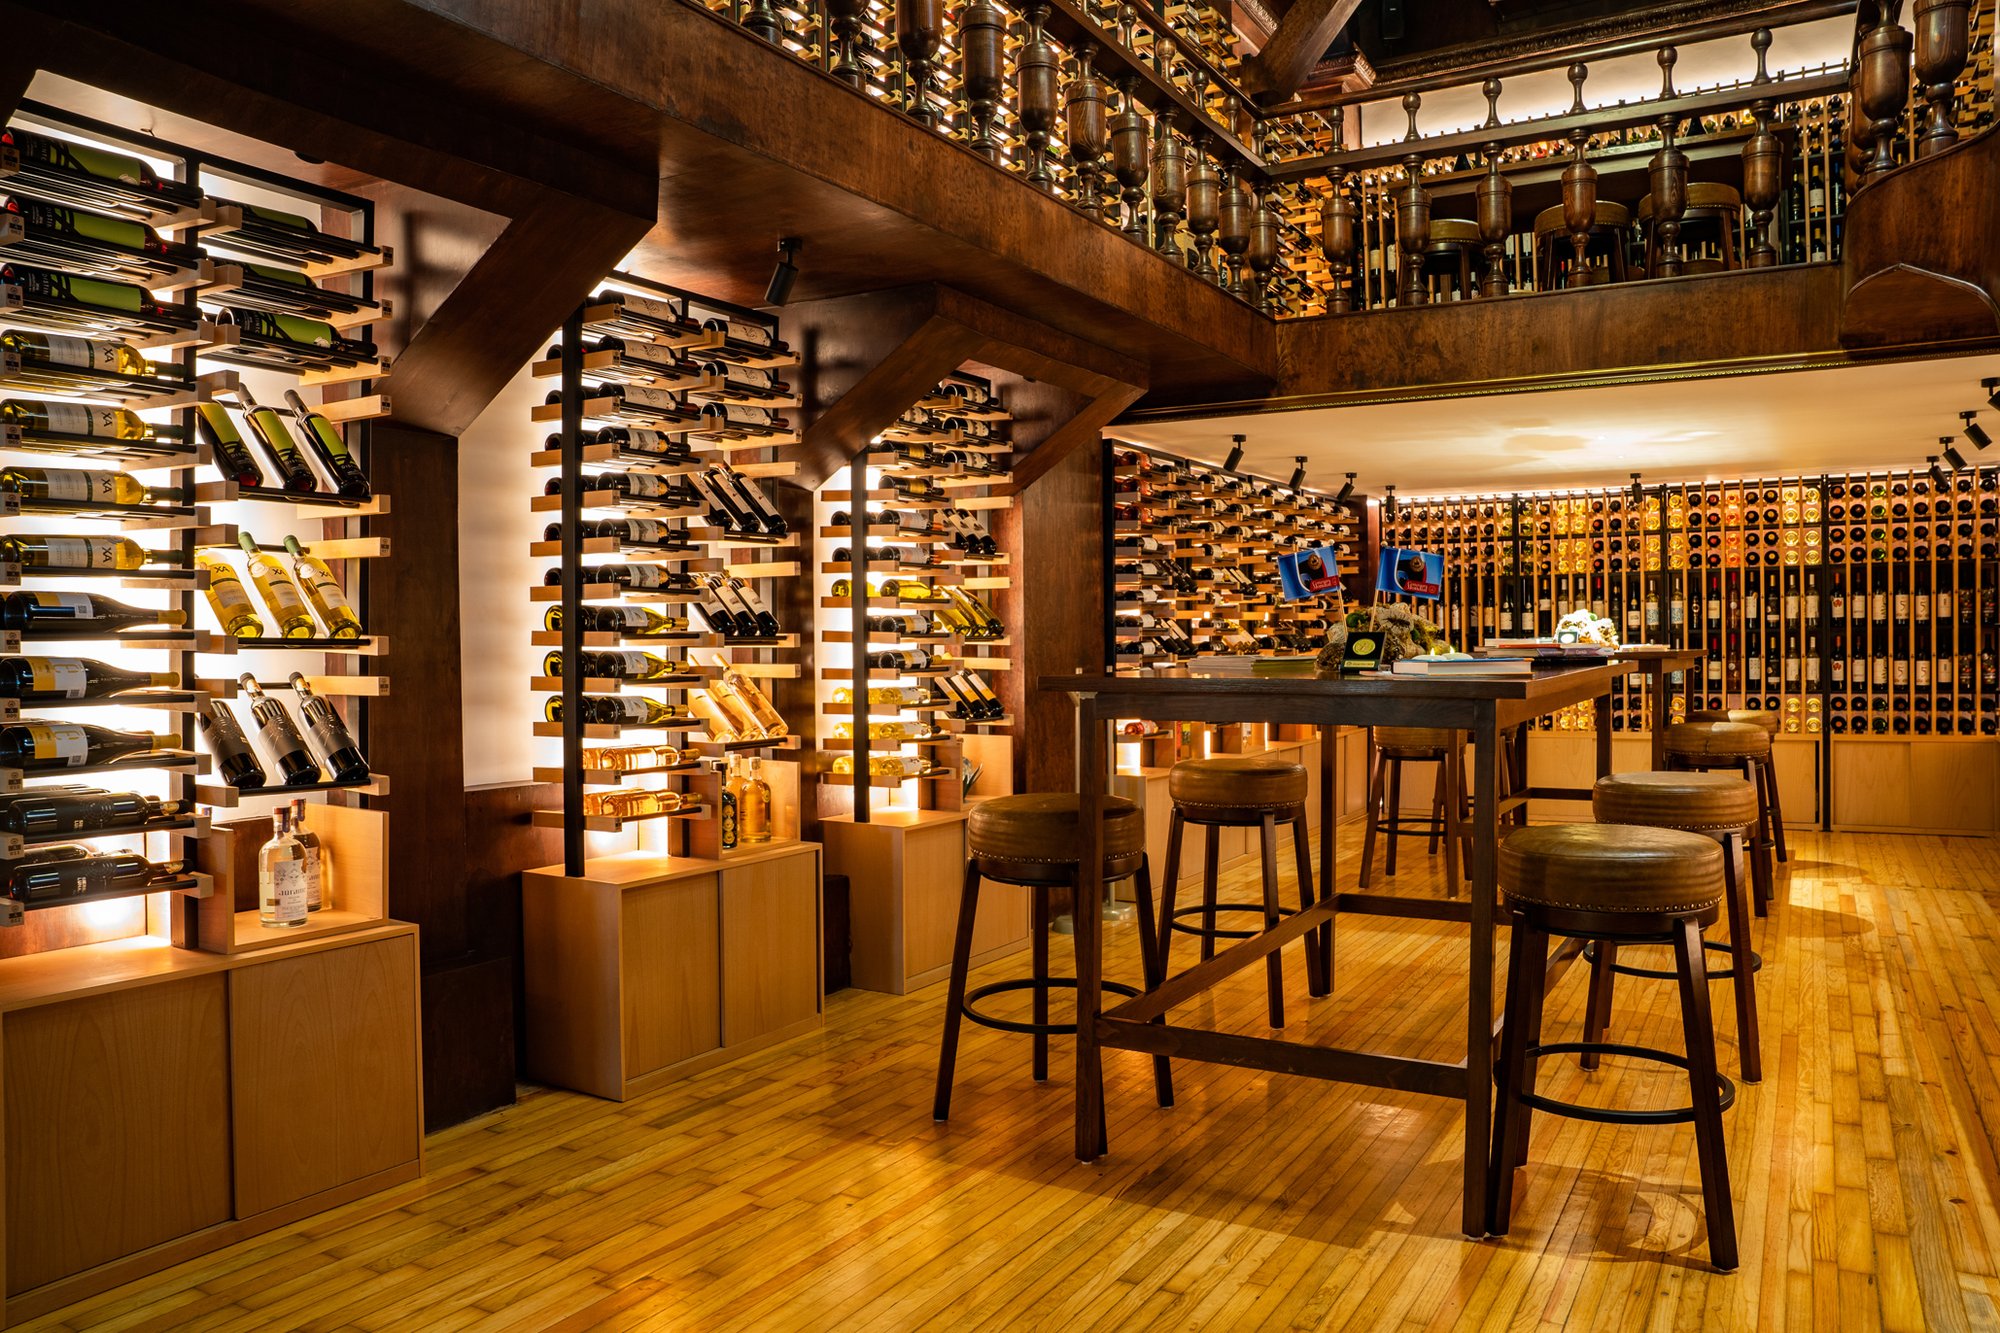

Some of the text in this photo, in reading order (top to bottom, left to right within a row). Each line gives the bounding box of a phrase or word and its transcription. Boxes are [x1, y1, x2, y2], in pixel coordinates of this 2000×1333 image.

[103, 347, 115, 363] XA
[102, 411, 113, 427] XA
[102, 478, 113, 494] XA
[102, 547, 113, 563] XA
